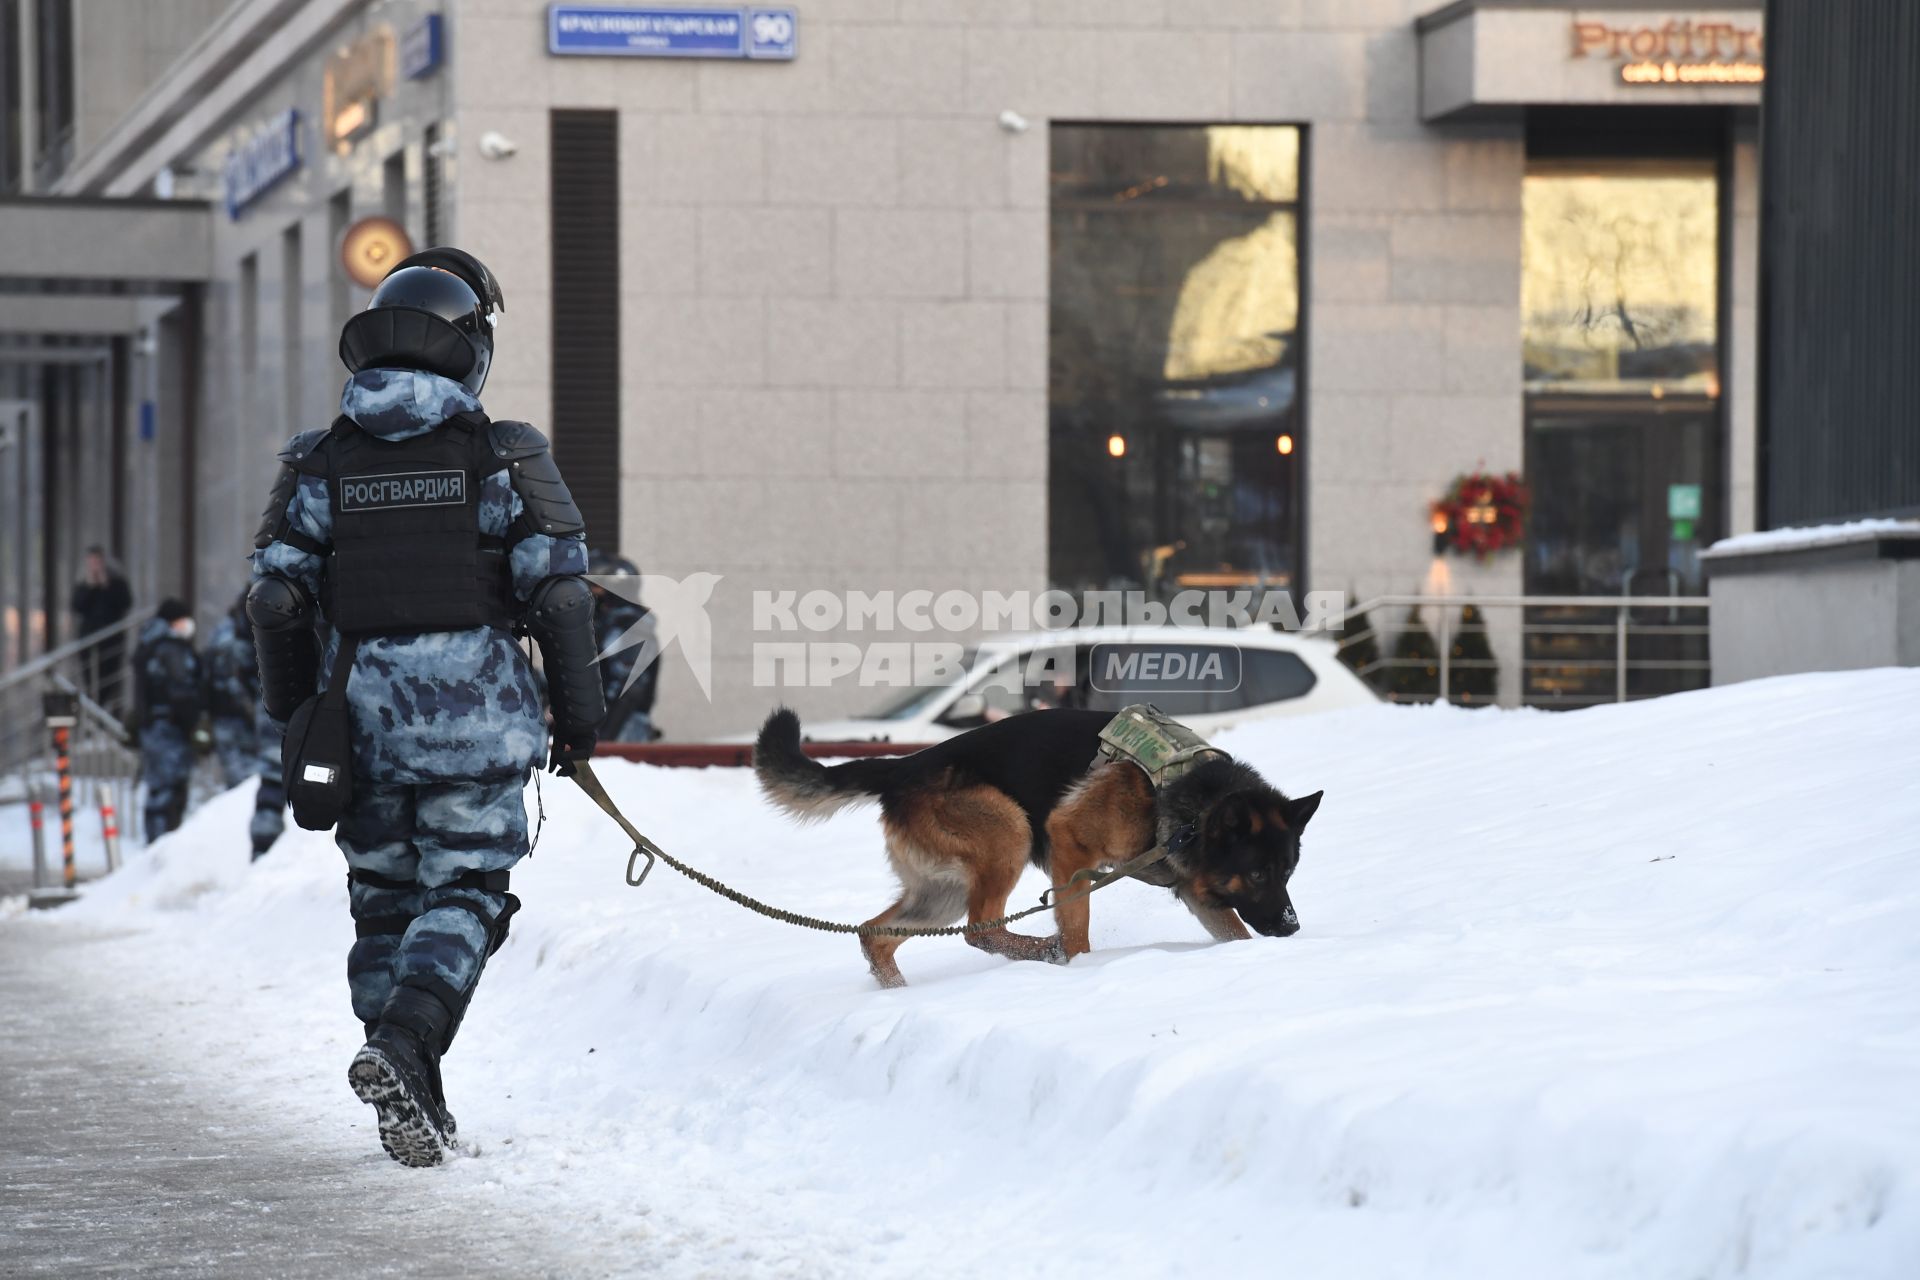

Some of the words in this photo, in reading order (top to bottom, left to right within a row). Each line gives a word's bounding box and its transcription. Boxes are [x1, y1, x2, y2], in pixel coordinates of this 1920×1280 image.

[753, 15, 792, 44] 90
[1573, 19, 1764, 58] ProfiTr
[344, 477, 461, 504] РОСГВАРДИЯ
